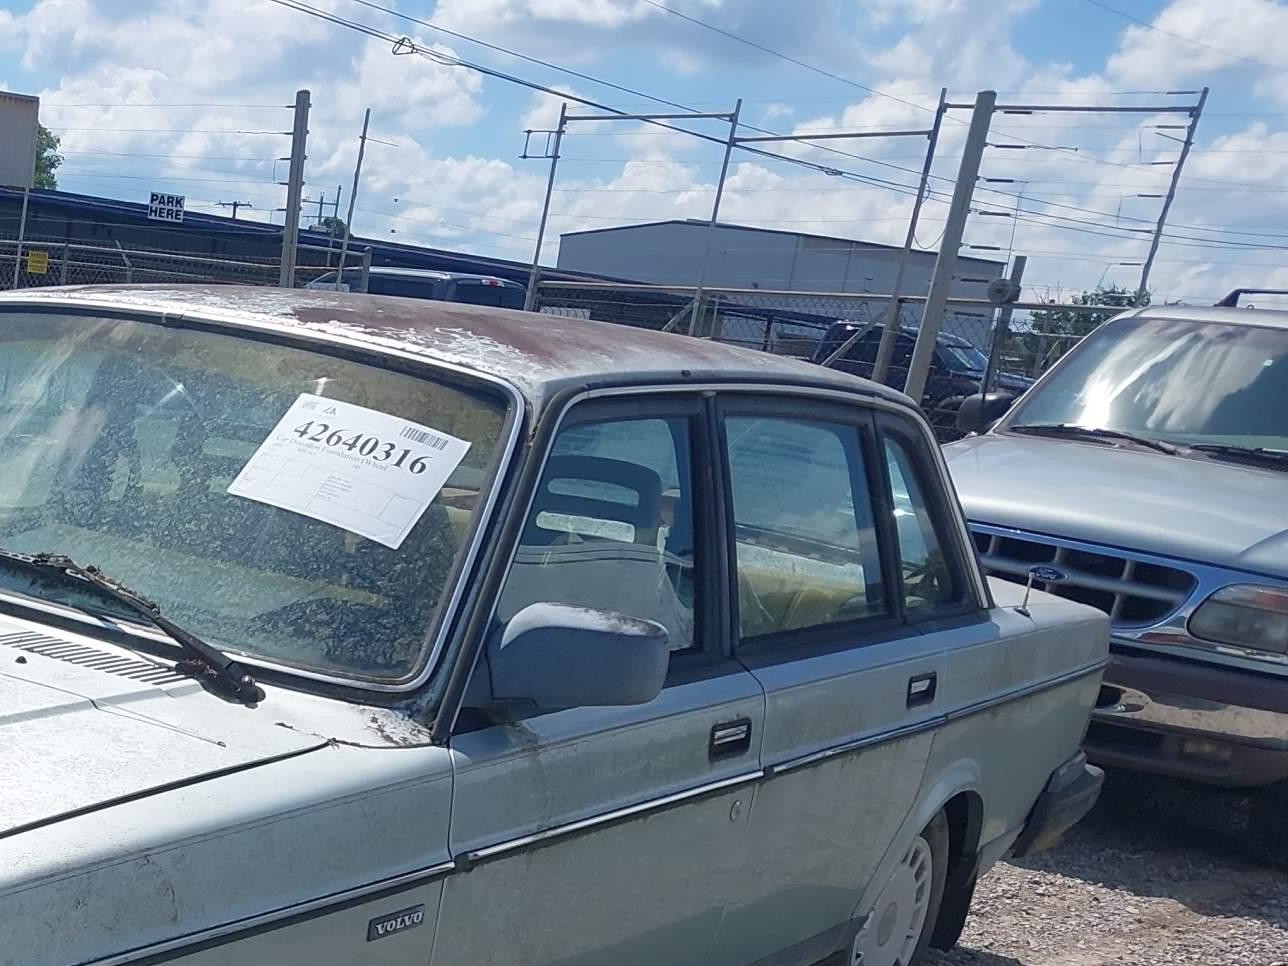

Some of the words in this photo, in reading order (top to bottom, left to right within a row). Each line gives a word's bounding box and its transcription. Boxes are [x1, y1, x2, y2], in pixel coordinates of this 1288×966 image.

[150, 193, 184, 208] PARK
[149, 206, 182, 220] HERE
[294, 420, 433, 474] 42640316
[376, 911, 422, 935] VOLVO
